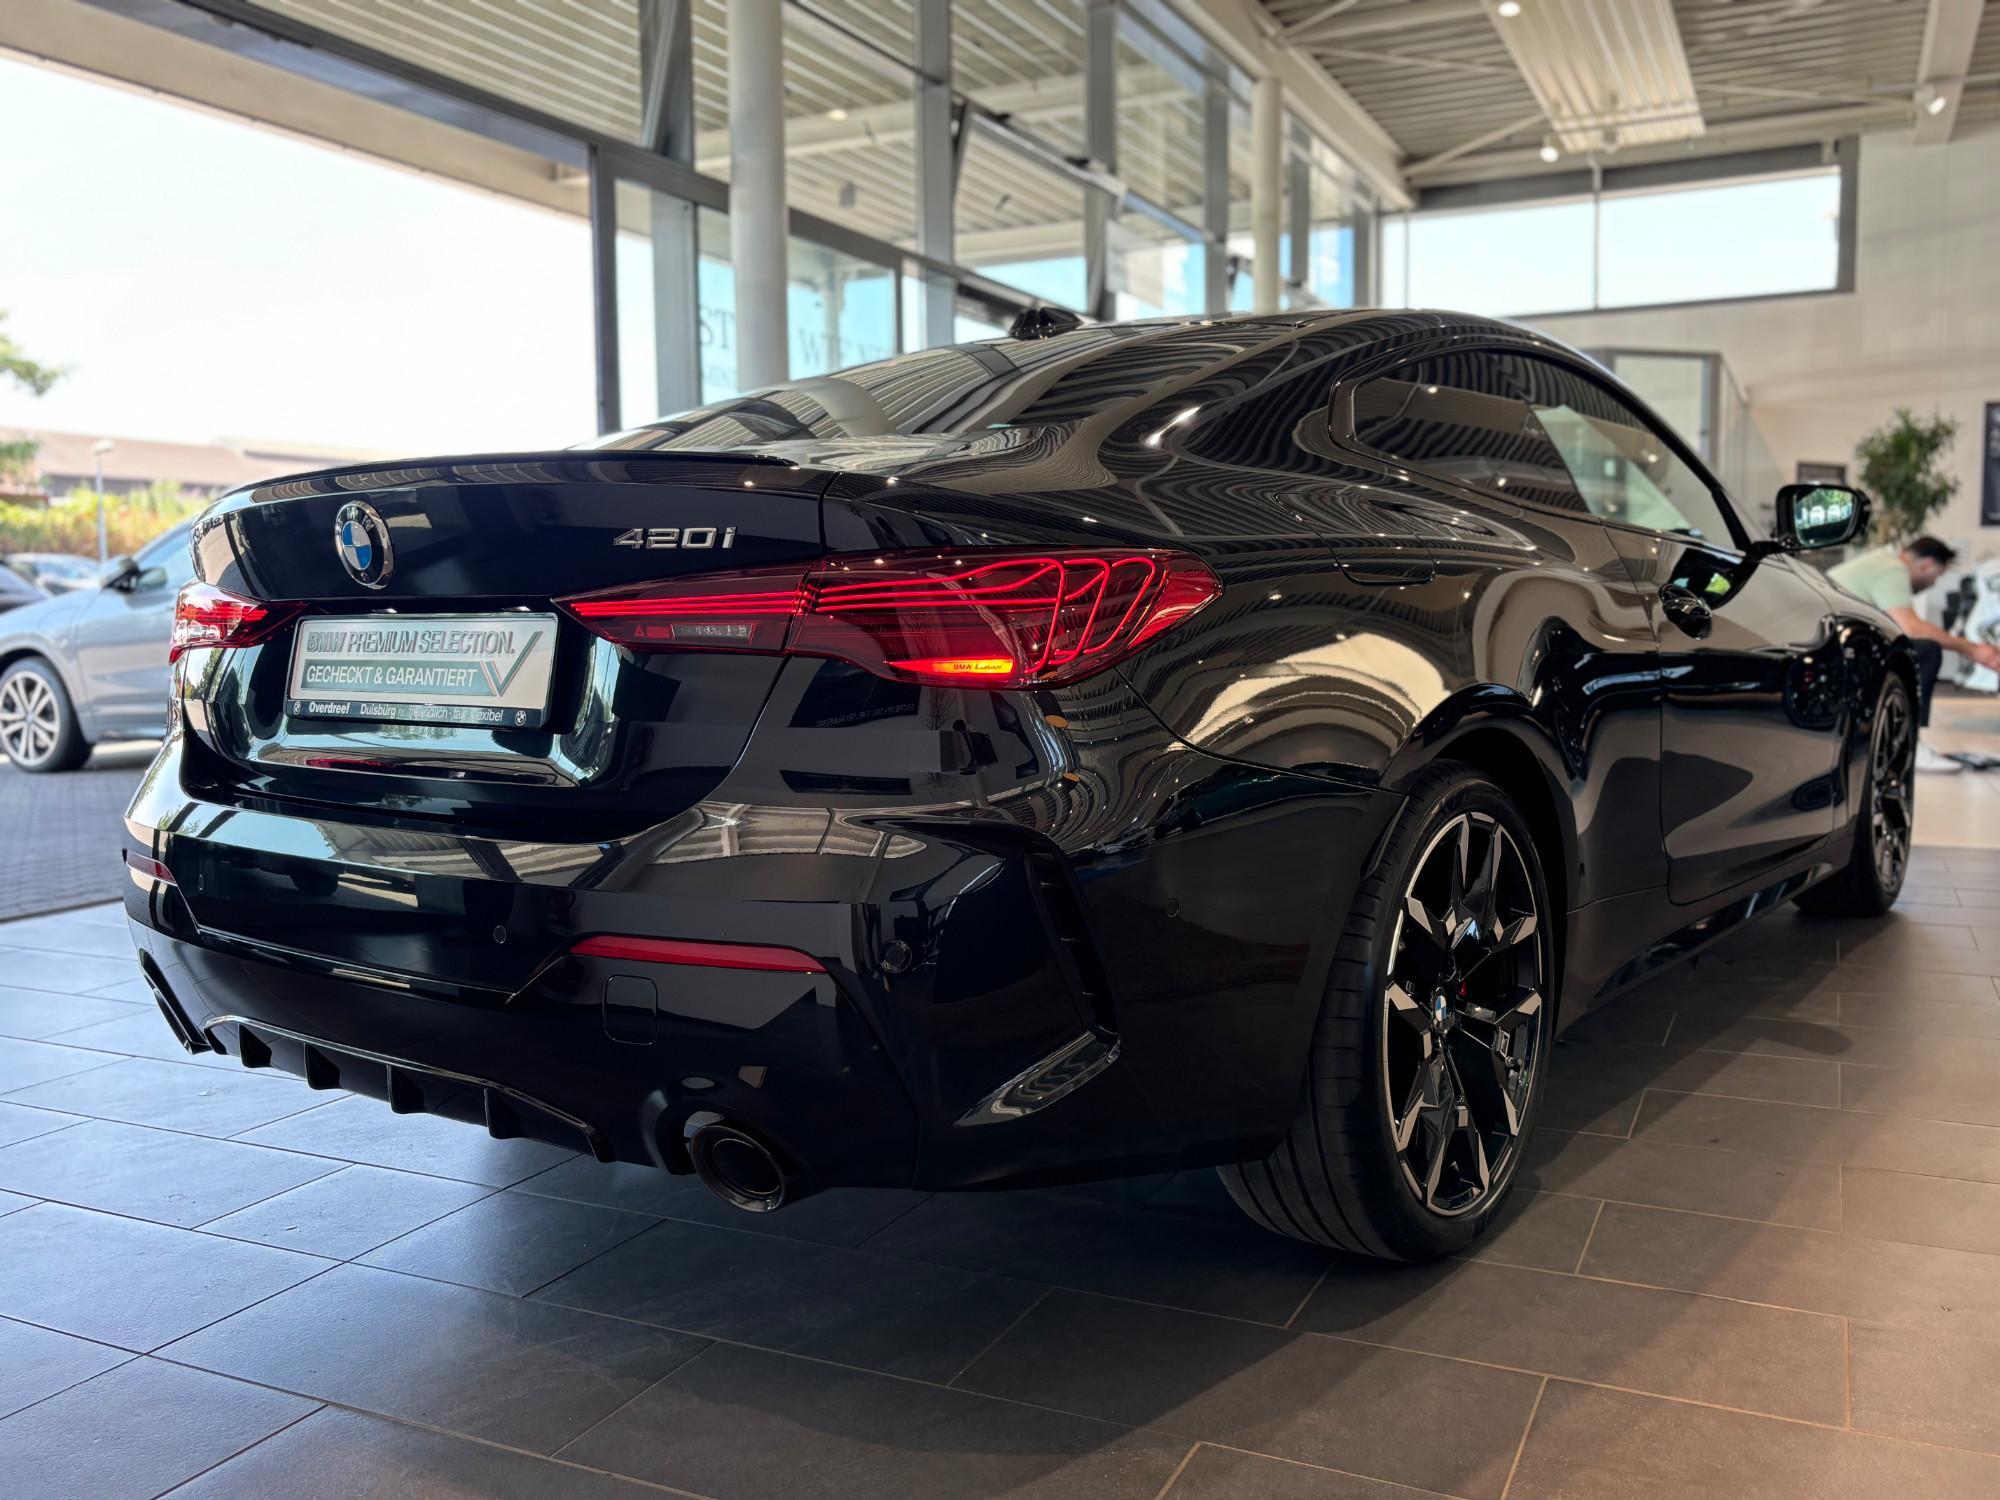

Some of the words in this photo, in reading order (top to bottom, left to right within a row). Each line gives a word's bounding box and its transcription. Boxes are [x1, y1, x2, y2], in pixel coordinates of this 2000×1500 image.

[612, 526, 737, 549] 420i
[307, 631, 348, 653] BMW
[347, 631, 418, 653] PREMIUM
[306, 665, 374, 684] GECHECKT
[374, 667, 384, 684] &
[386, 667, 478, 688] GARANTIERT
[953, 663, 973, 671] BMW
[360, 703, 396, 719] Duisburg
